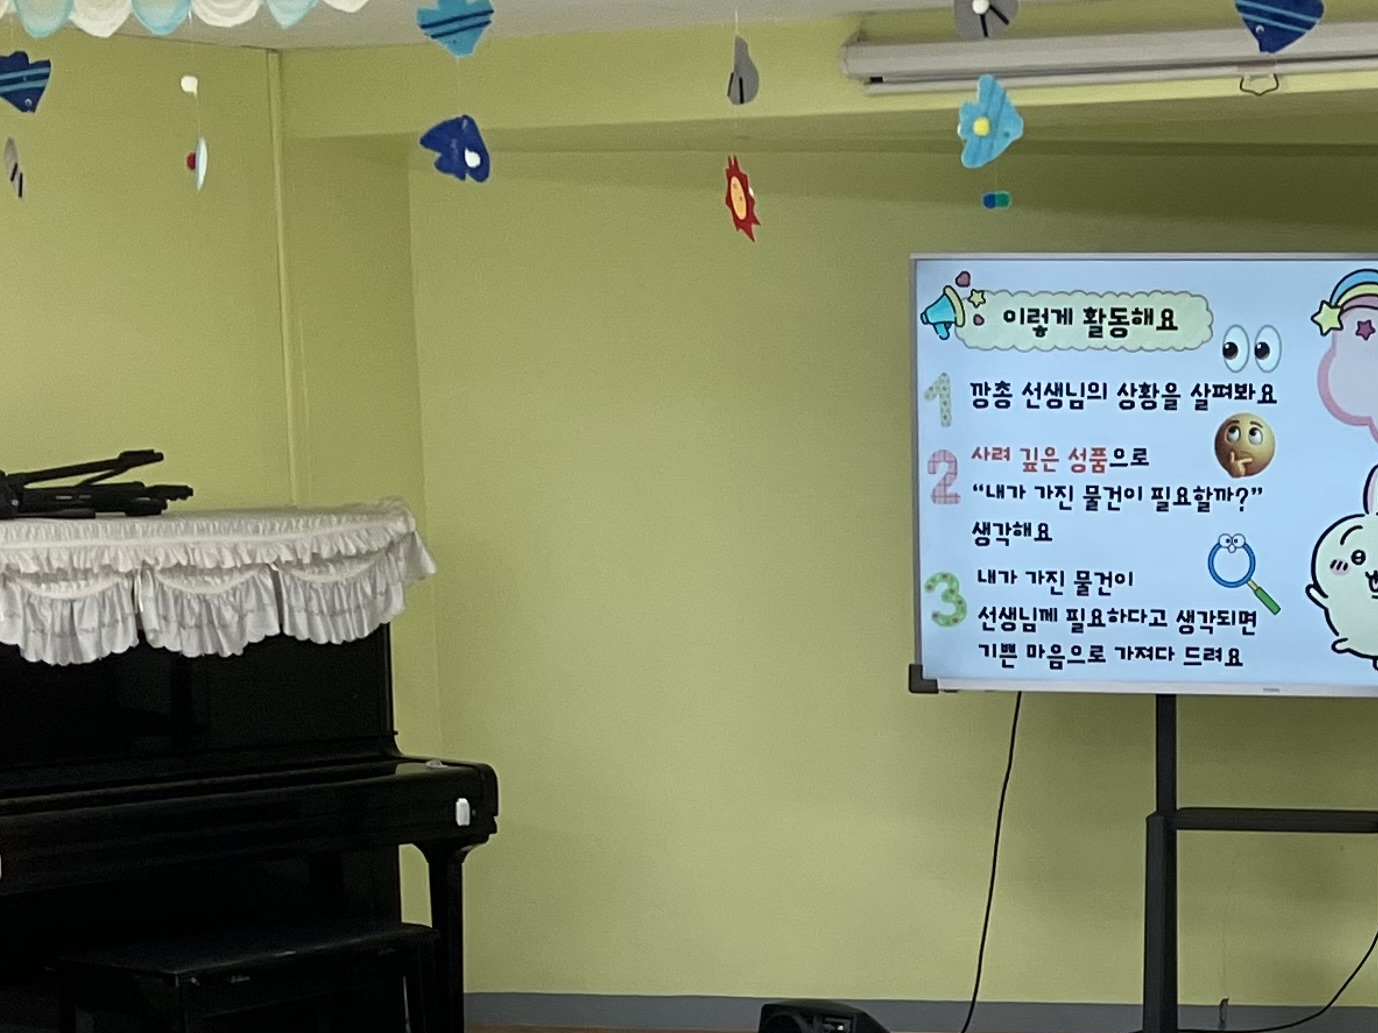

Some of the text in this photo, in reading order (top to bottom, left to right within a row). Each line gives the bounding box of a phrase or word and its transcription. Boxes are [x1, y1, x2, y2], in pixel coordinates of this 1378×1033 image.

[1003, 307, 1178, 338] 이렇게 활동해요
[924, 372, 952, 428] 1
[970, 380, 1278, 411] 깡총 선생님의 상황을 살펴봐요
[971, 447, 1149, 473] 사려 깊은 성품으로
[927, 449, 961, 504] 2
[1035, 485, 1074, 511] 가진
[1083, 485, 1143, 511] 물건이
[972, 521, 1053, 547] 생각해요
[977, 569, 1134, 596] 내가 가진 물건이
[924, 572, 967, 627] 3
[977, 606, 1257, 636] 선생님께 필요하다고 생각되면
[977, 643, 1243, 669] 기쁜 마음으로 가져다 드려요
